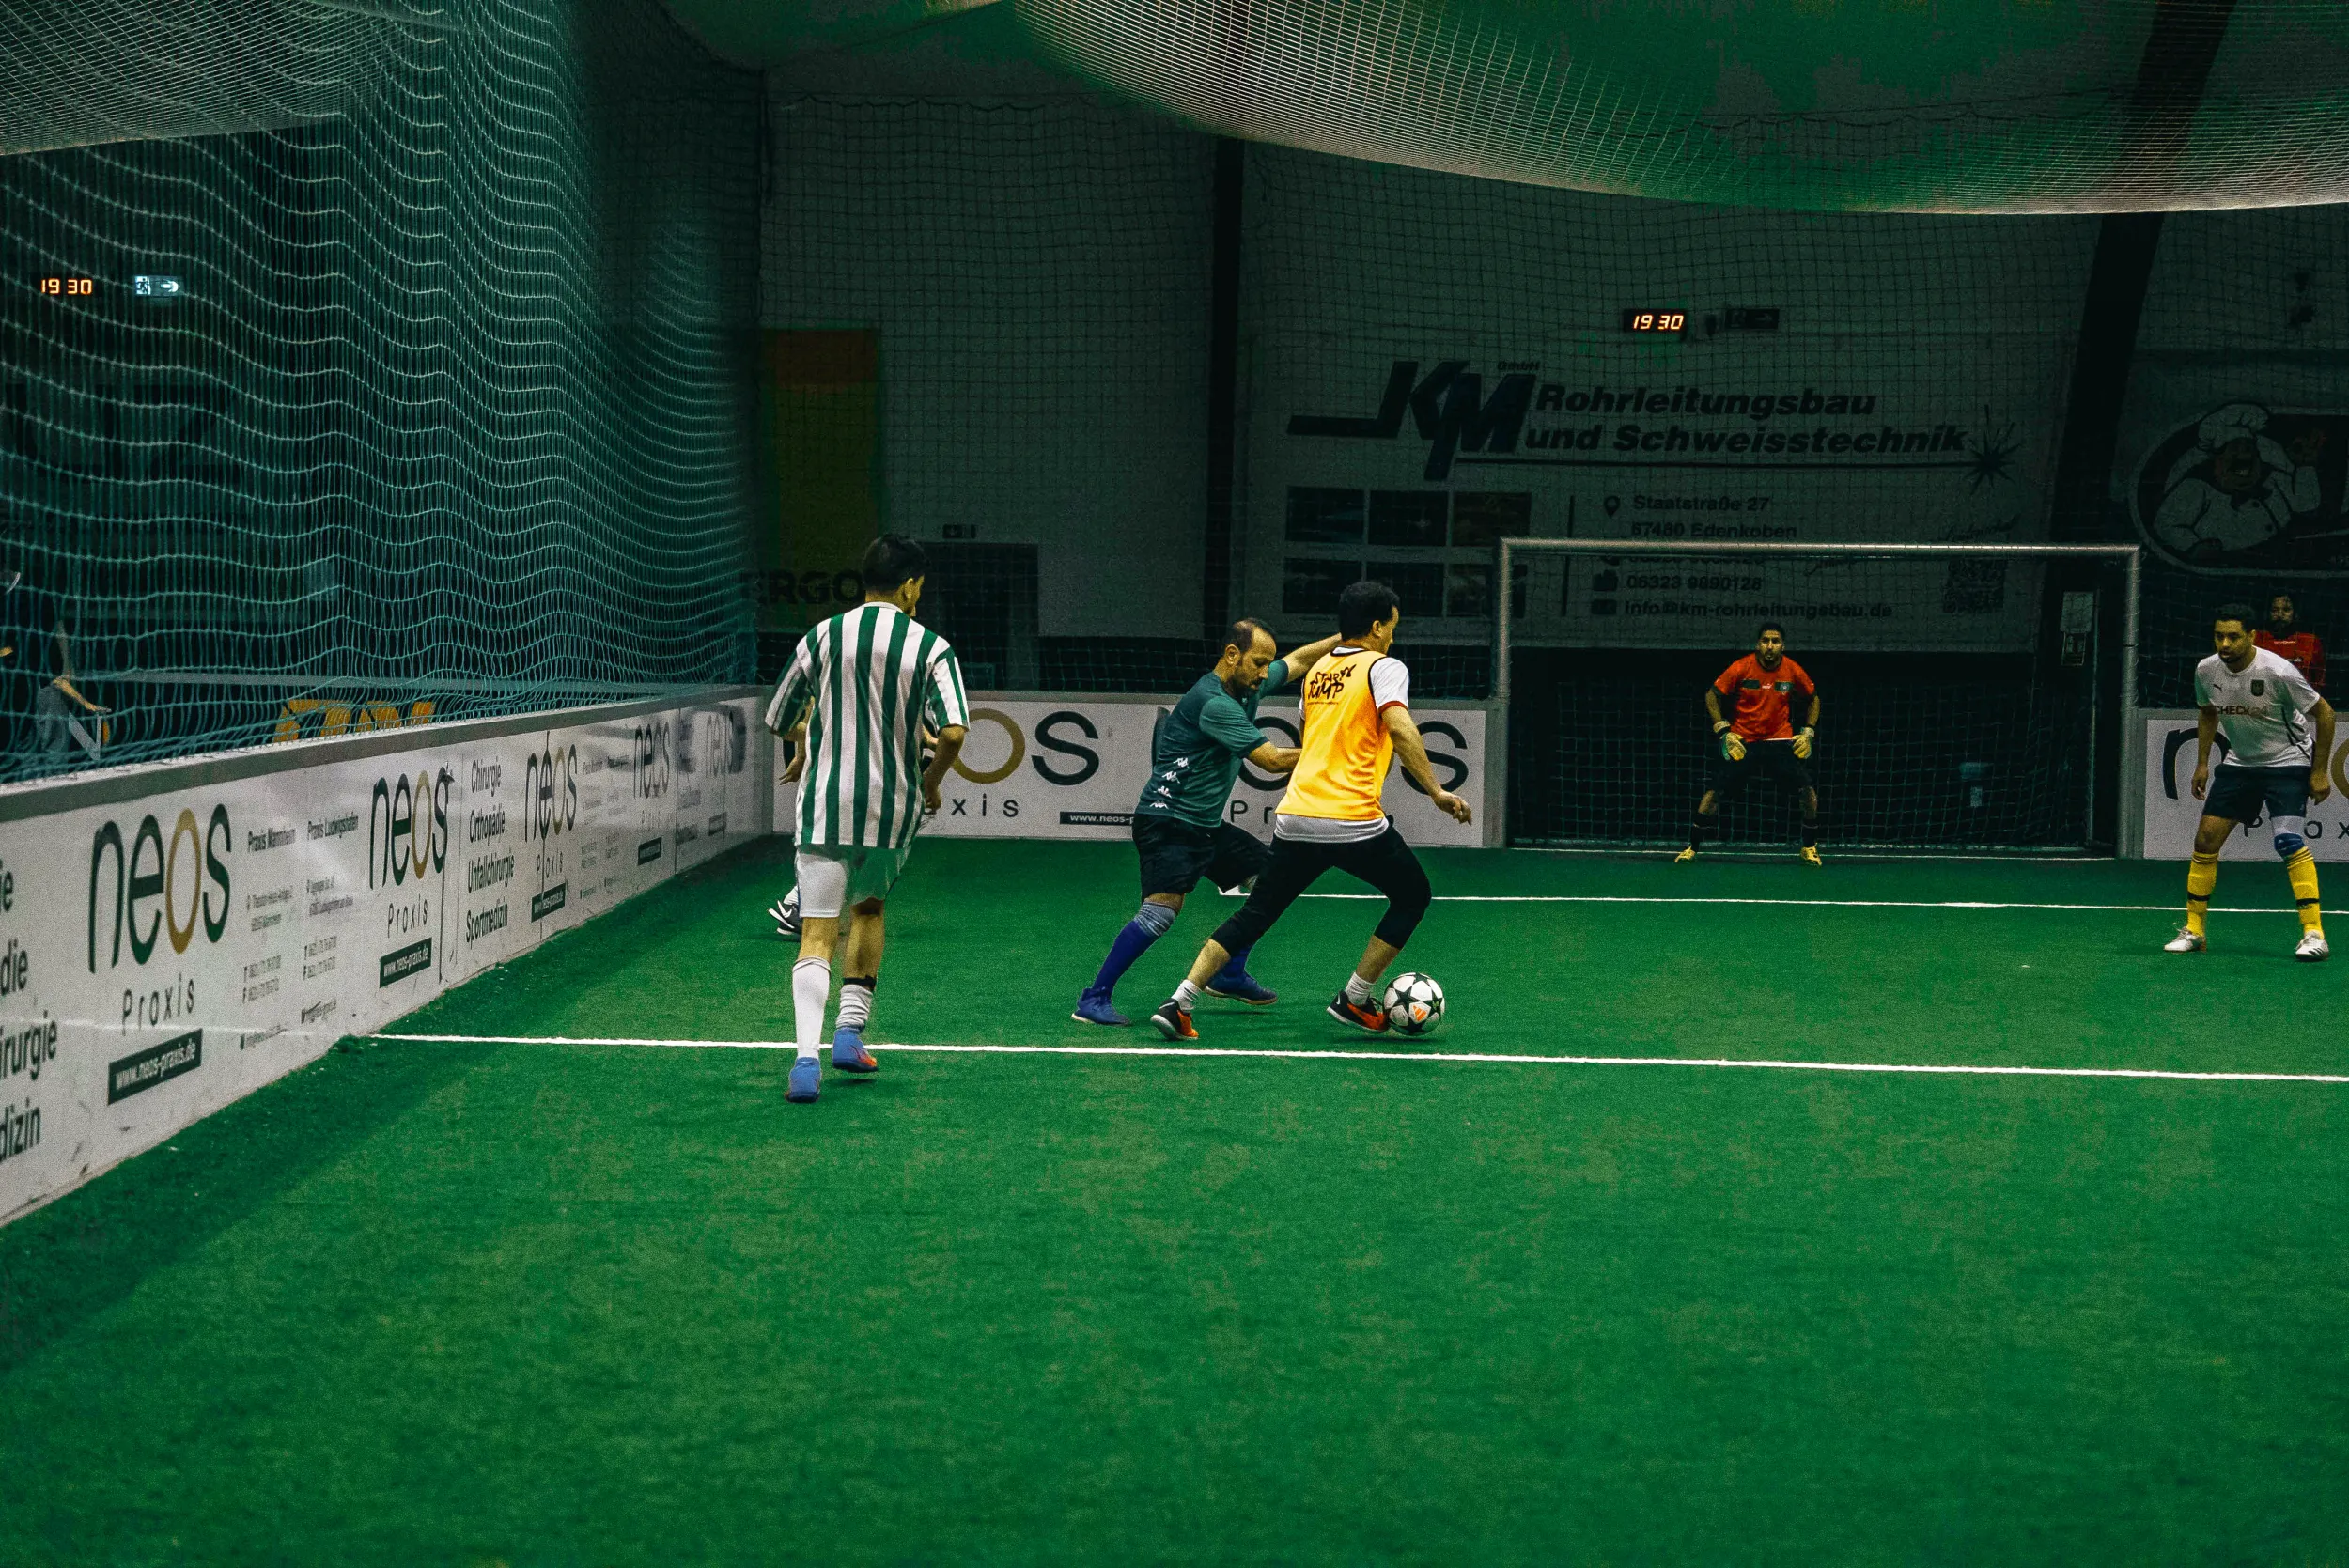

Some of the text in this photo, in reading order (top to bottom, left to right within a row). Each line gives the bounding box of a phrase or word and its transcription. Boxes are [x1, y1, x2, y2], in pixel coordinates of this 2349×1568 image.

[1633, 314, 1685, 330] 19 30
[1536, 383, 1876, 420] Rohrleitungsbau
[1524, 422, 1967, 455] und Schweisstechnik
[1747, 496, 1771, 512] 27
[1691, 522, 1798, 539] Edenkoben
[1626, 575, 1681, 590] 06323
[1625, 600, 1893, 620] info@km-rohrleitungsbau.de
[471, 756, 502, 797] Chirurgie
[633, 722, 670, 799] neos
[524, 744, 577, 843] neos
[369, 767, 448, 890] neos
[468, 846, 515, 893] Unfallchirurgie
[537, 847, 563, 881] Paxis
[87, 803, 231, 974] neos
[465, 896, 508, 949] Sportmedizin
[382, 943, 428, 978] www.neos-praxis.de
[116, 1038, 196, 1090] www.neos-praxis.de
